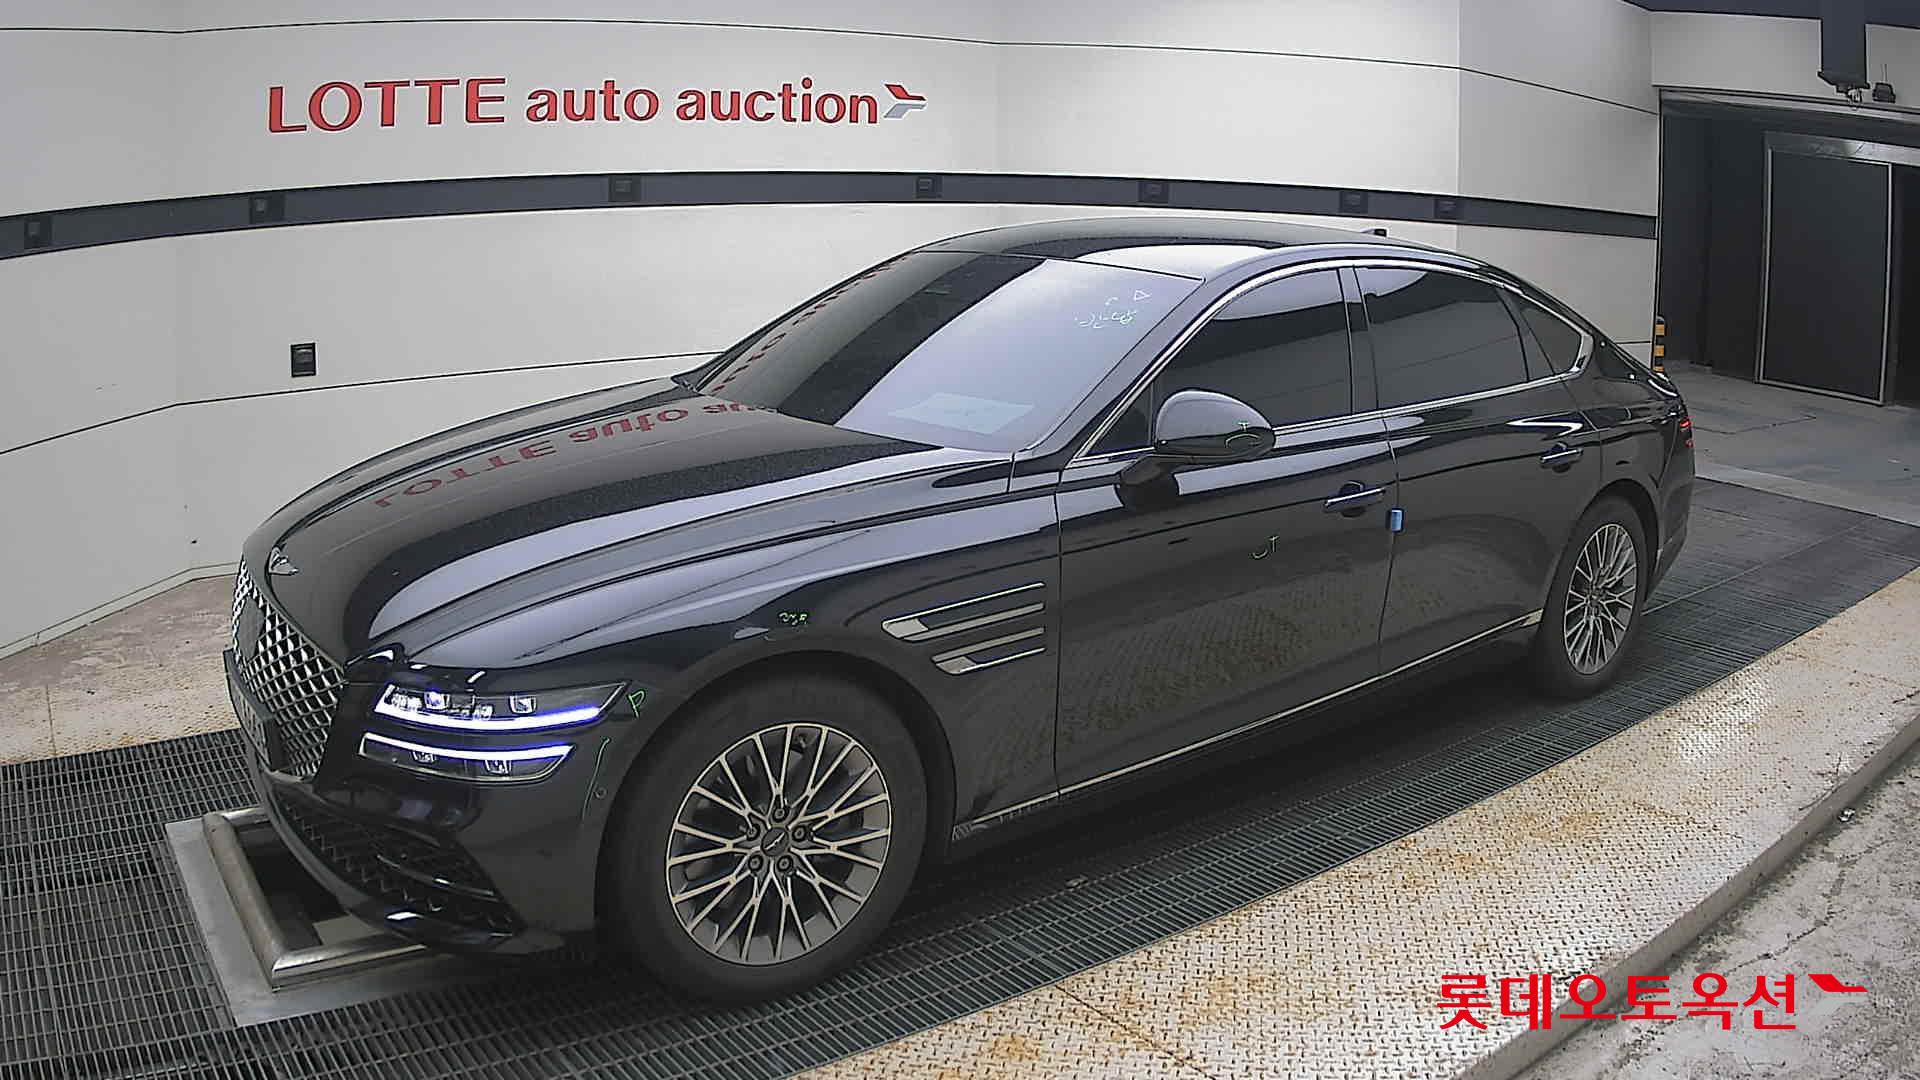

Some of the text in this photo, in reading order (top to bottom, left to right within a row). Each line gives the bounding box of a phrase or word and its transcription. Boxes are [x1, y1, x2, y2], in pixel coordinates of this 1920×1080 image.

[268, 78, 879, 134] LOTTE auto auction
